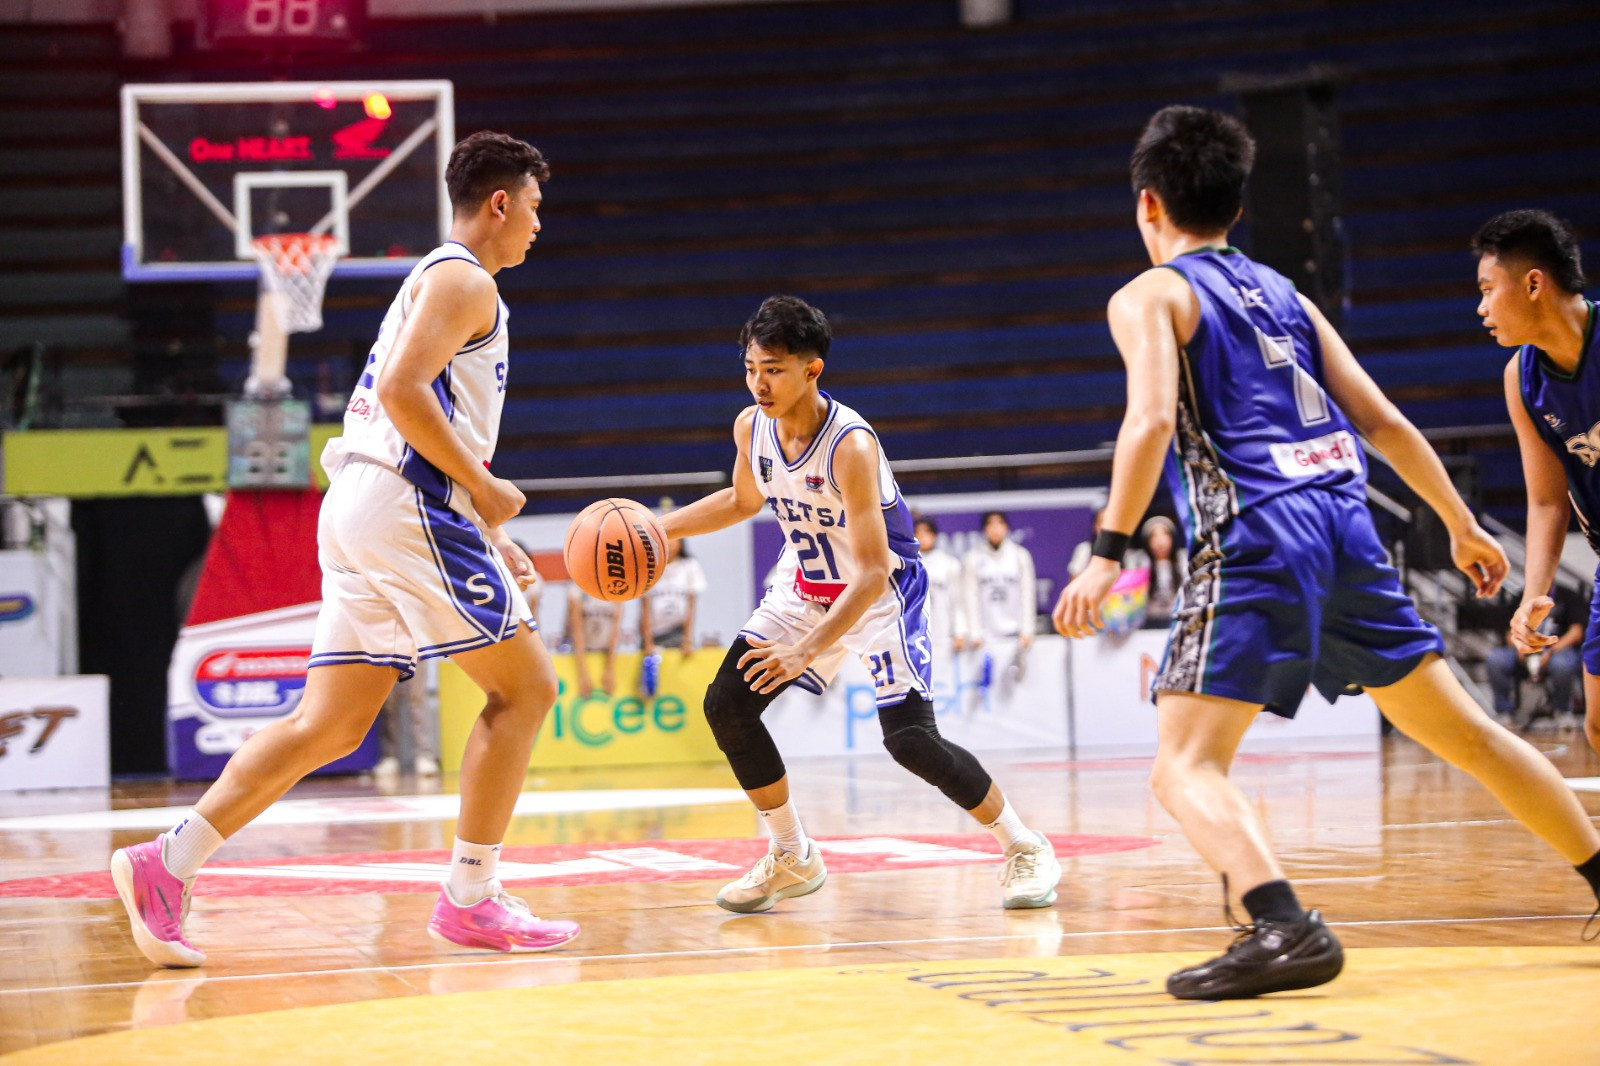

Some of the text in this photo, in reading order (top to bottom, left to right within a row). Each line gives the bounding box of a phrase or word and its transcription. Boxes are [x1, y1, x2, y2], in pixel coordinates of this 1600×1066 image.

[606, 539, 626, 580] DBL
[790, 529, 841, 580] 21
[465, 572, 496, 606] S
[914, 635, 931, 665] S
[869, 651, 895, 688] 21
[553, 679, 687, 747] icee
[459, 856, 482, 866] DBL
